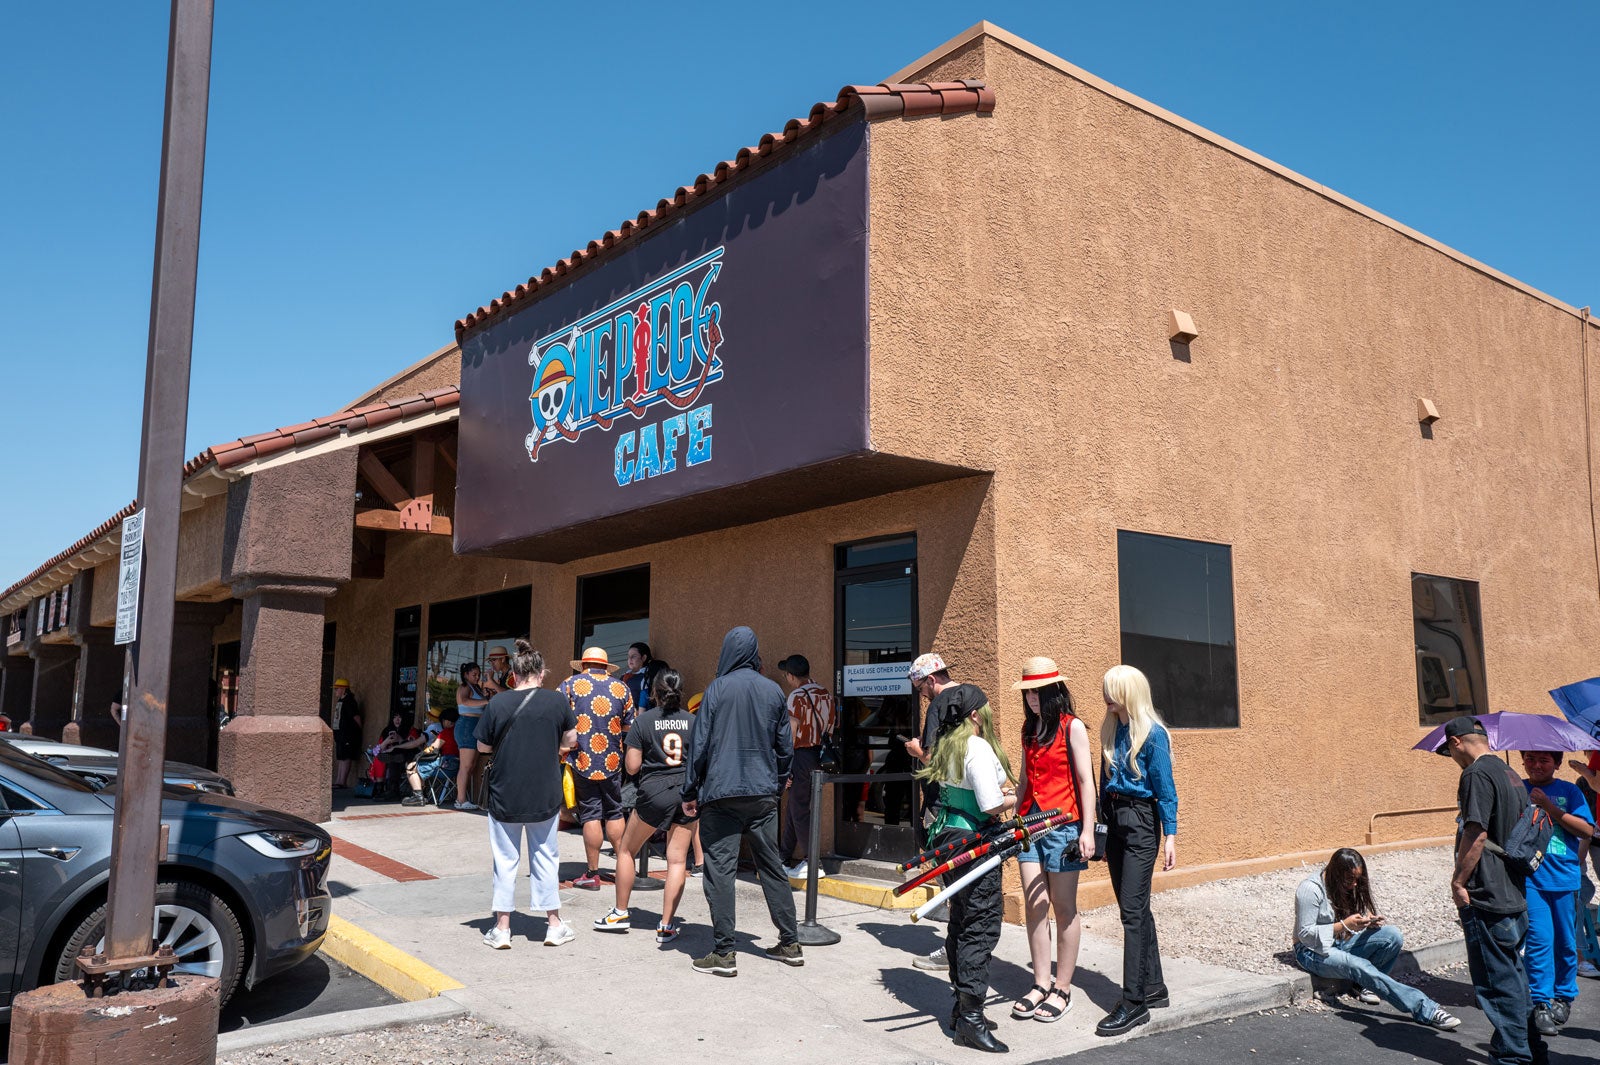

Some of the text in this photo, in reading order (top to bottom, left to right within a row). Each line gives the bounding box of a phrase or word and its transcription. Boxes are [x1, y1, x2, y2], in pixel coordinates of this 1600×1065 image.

[531, 261, 724, 432] ONE PIECE
[613, 404, 712, 486] CAFE
[654, 720, 689, 730] BURROW
[662, 732, 683, 767] 9
